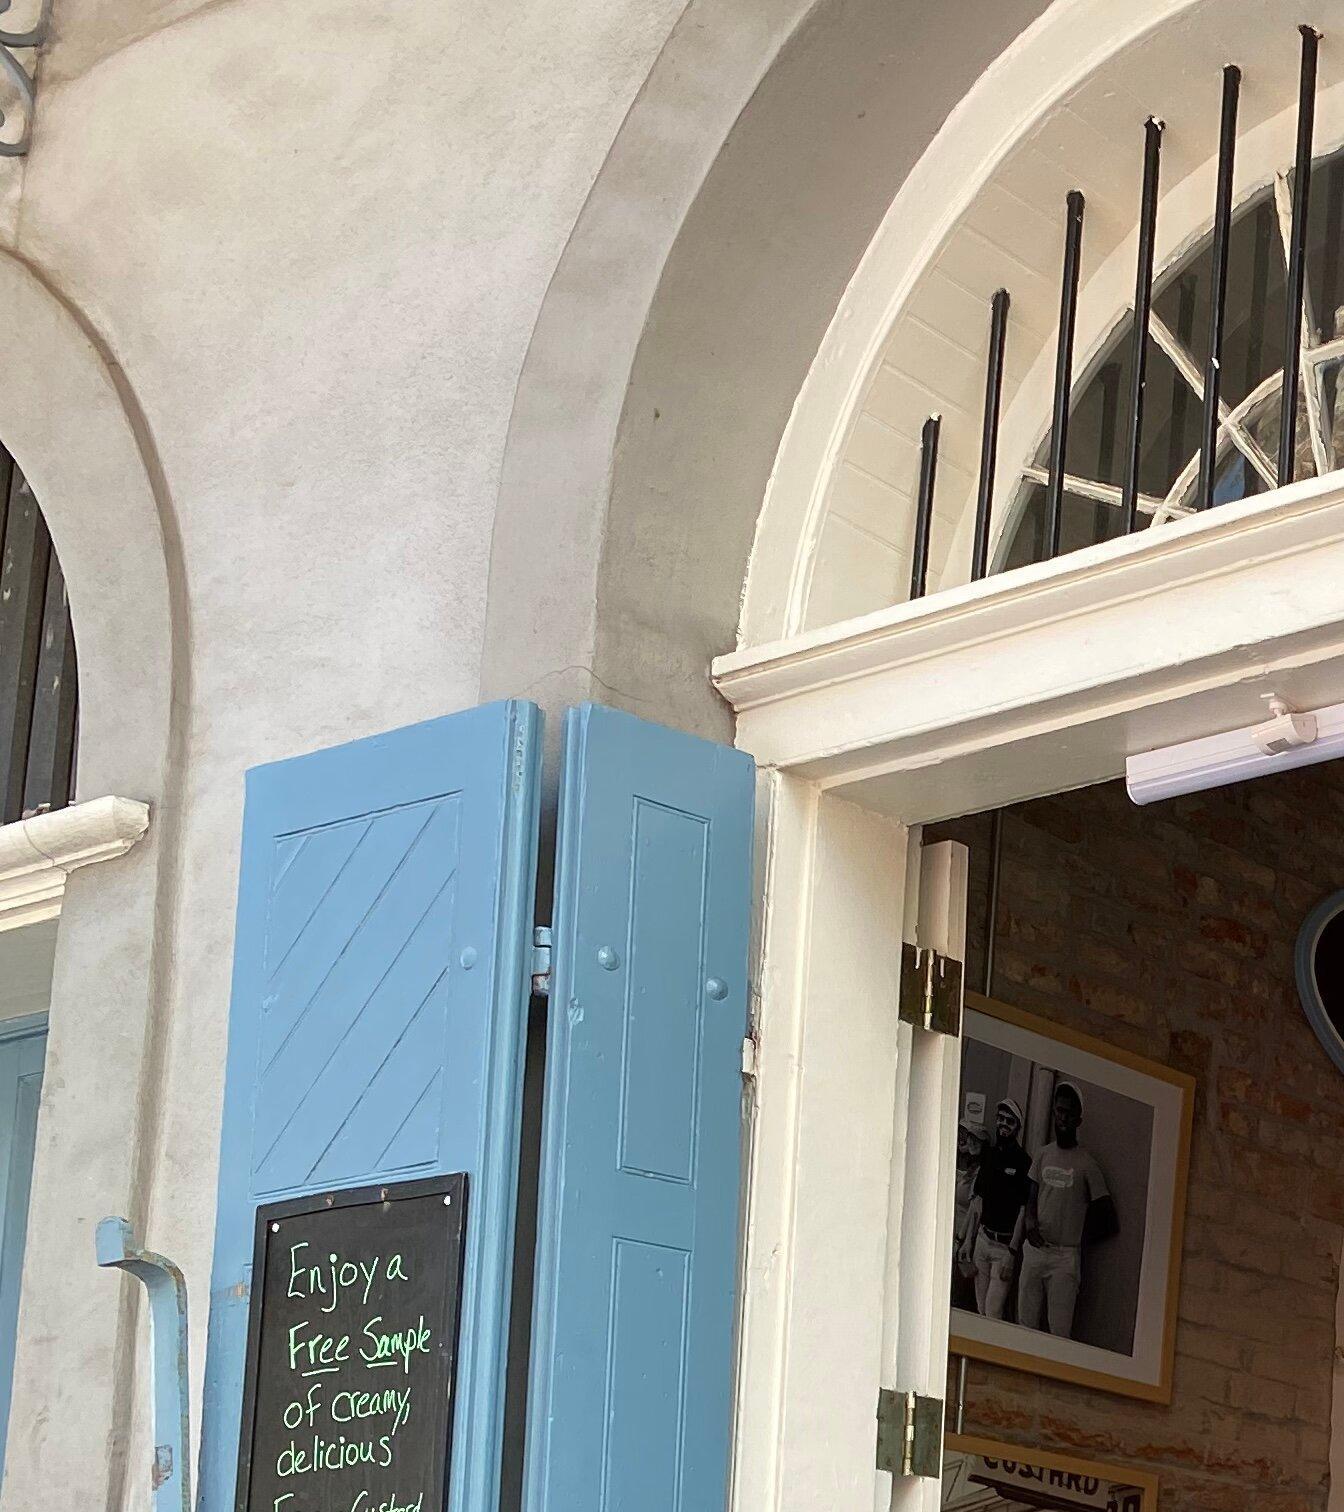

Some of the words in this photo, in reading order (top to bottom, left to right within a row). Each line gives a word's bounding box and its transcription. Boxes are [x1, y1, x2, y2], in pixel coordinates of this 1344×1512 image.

[287, 1242, 379, 1313] Enjoy
[386, 1253, 409, 1281] a
[288, 1322, 350, 1370] Free
[359, 1315, 431, 1374] Sample
[283, 1384, 322, 1430] of
[277, 1435, 392, 1477] delicious
